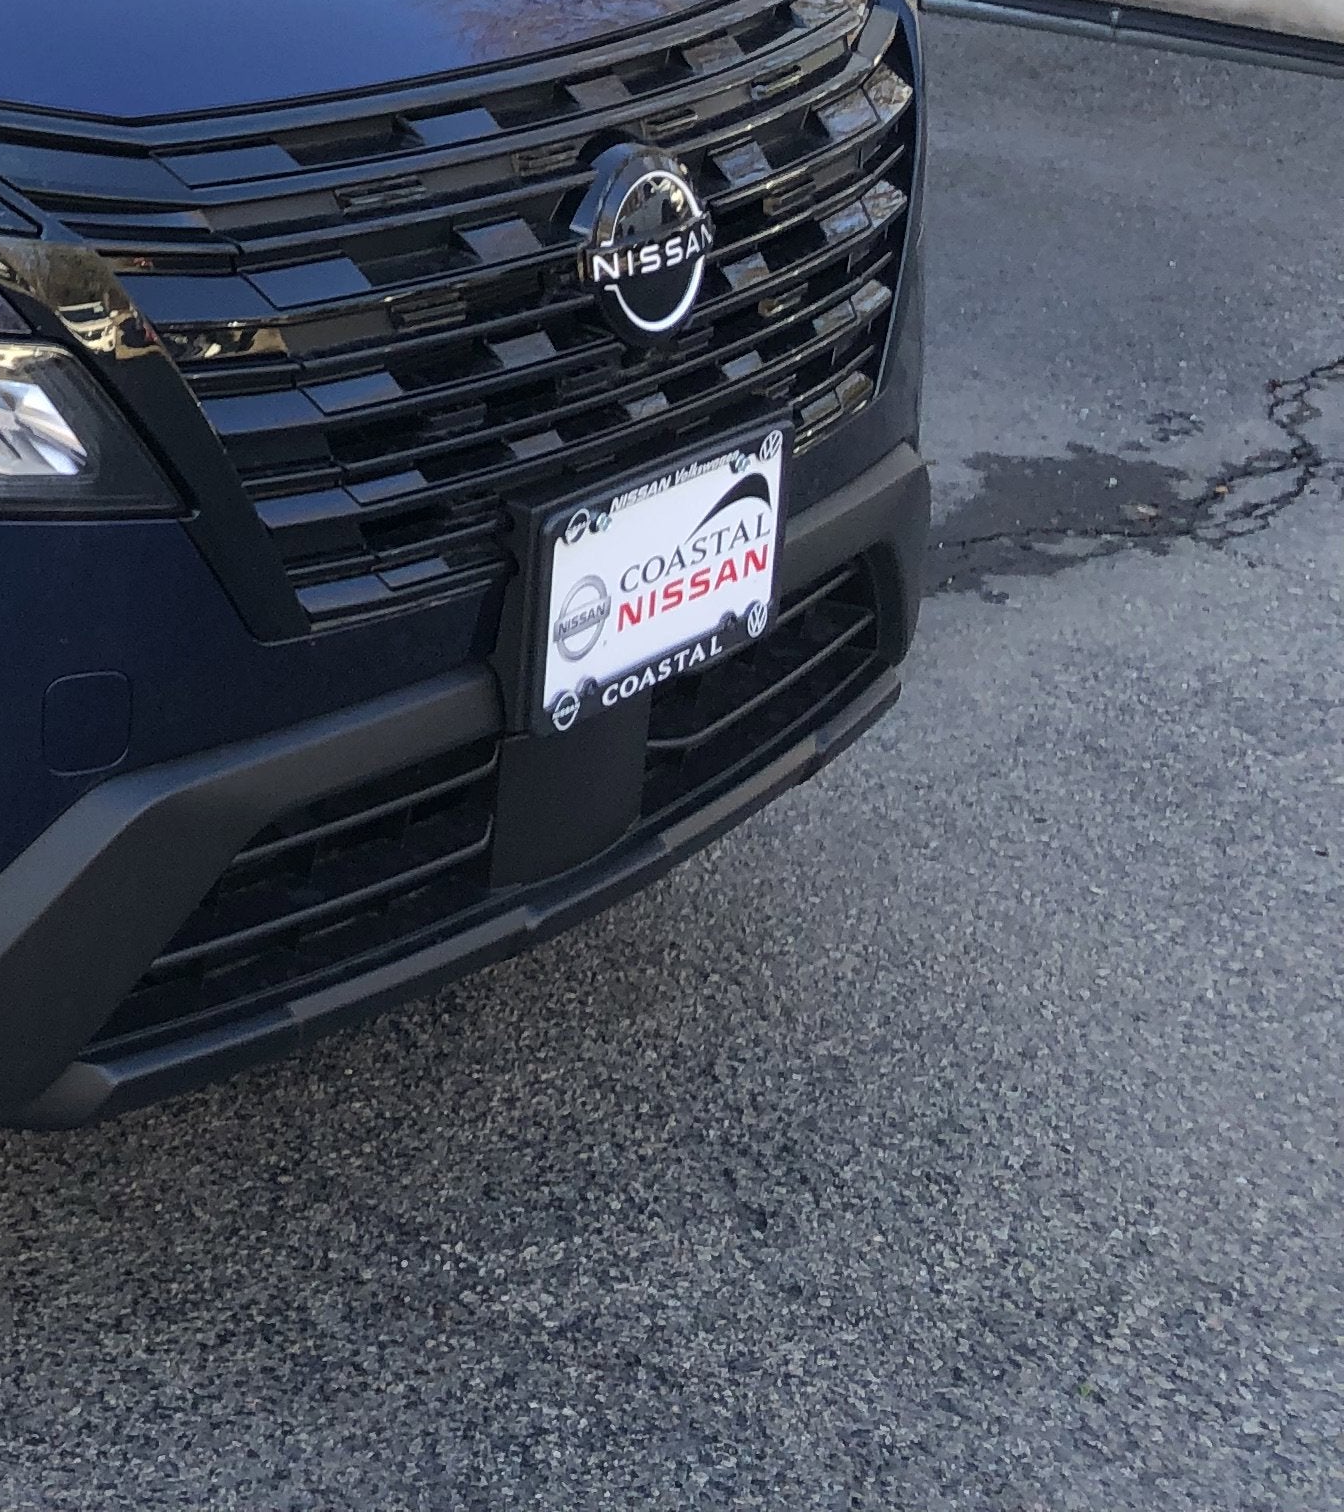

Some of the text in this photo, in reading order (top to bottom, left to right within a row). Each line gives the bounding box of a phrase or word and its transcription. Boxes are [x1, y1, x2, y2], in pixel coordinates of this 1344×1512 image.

[593, 223, 713, 283] NISSAN
[609, 475, 672, 514] NISSAN
[620, 512, 771, 593] COASTAL
[558, 602, 606, 636] NISSAN
[617, 544, 769, 633] NISSAN
[601, 635, 723, 707] COASTAL
